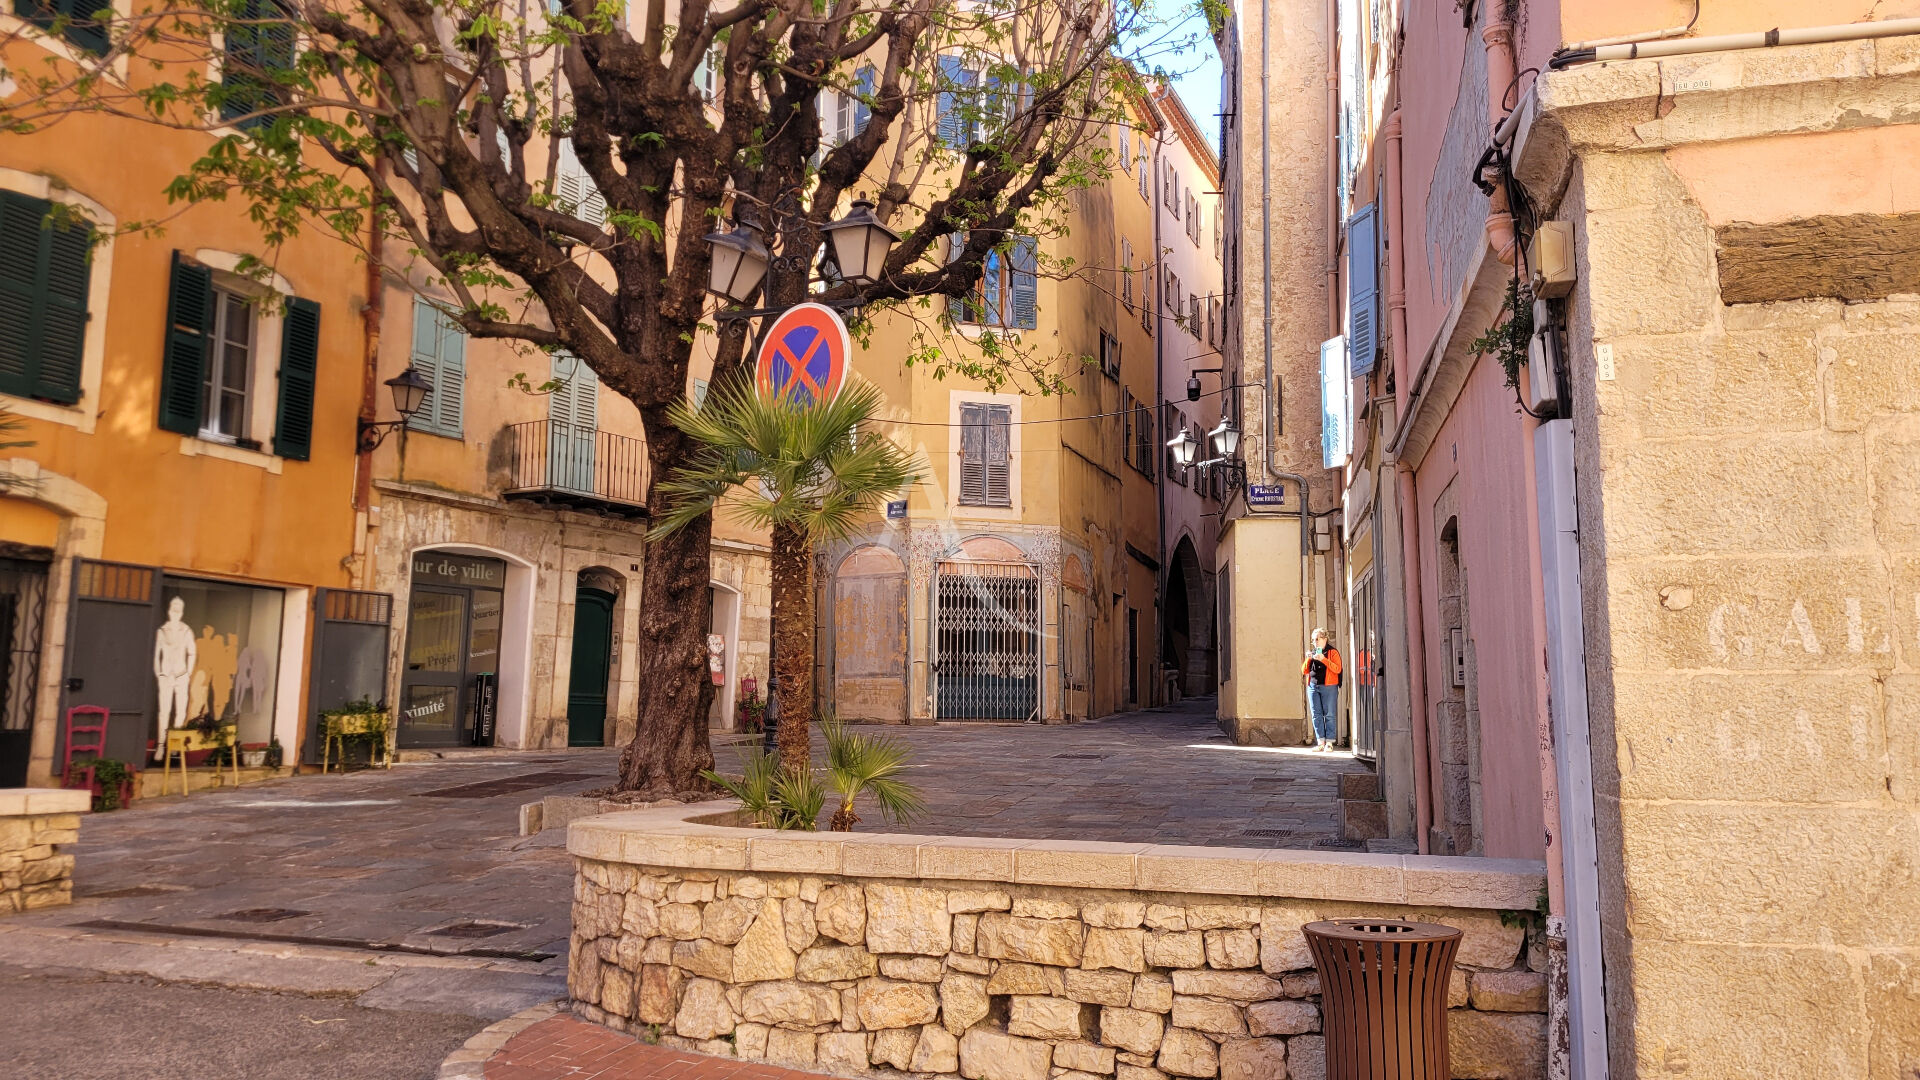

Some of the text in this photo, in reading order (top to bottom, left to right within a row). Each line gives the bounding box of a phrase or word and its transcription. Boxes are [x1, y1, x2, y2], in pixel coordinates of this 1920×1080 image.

[438, 560, 457, 576] de
[461, 563, 494, 580] ville
[1708, 597, 1920, 658] GAL
